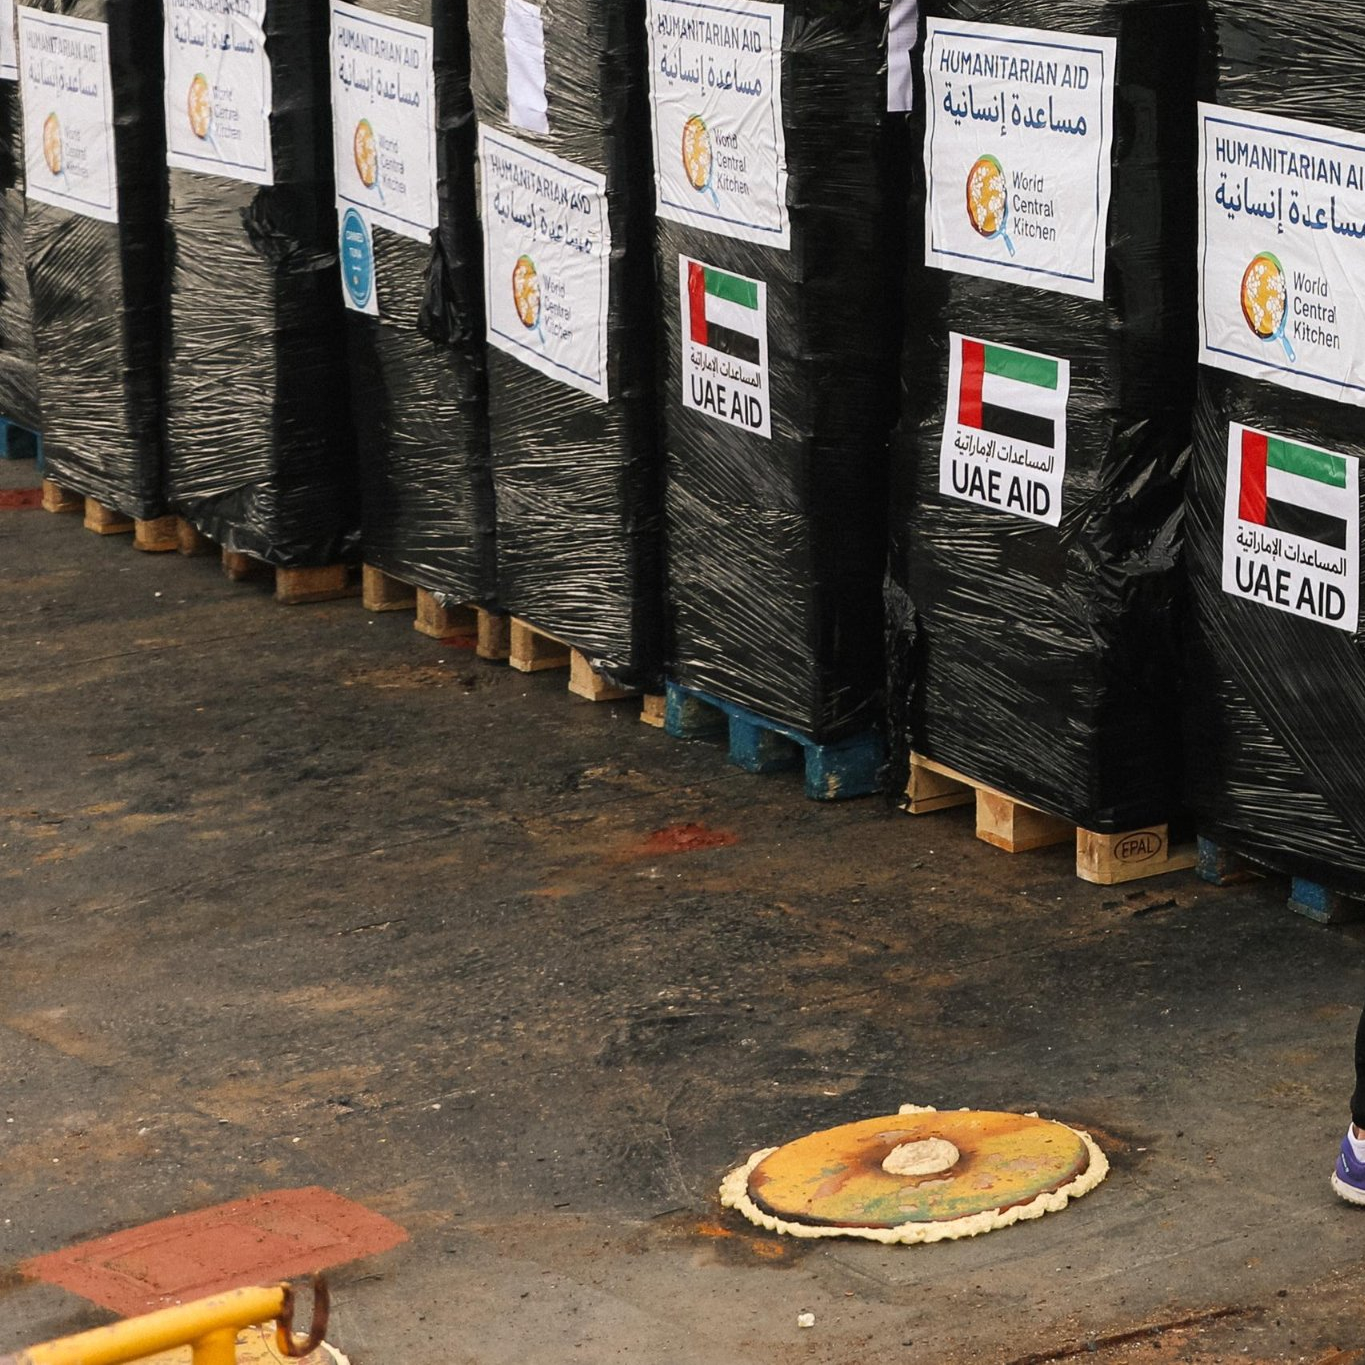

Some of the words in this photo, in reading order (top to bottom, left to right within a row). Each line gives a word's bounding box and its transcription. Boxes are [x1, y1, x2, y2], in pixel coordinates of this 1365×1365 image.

[337, 25, 401, 63] HUMANITARIAN
[402, 45, 420, 70] AID
[658, 13, 740, 50] HUMANITARIAN
[741, 28, 762, 54] AID
[660, 44, 707, 97] إنسانية
[707, 56, 762, 97] مساعدة
[939, 48, 1058, 86] HUMANITARIAN
[1060, 63, 1089, 90] AID
[942, 82, 1007, 137] إنسانية
[1011, 93, 1087, 137] مساعدة
[713, 128, 738, 149] World
[716, 150, 747, 174] Central
[1215, 137, 1342, 186] HUMANITARIAN
[490, 154, 568, 207] HUMANITARIAN
[571, 191, 591, 215] AID
[716, 174, 750, 196] Kitchen
[1012, 171, 1044, 194] World
[1012, 194, 1054, 218] Central
[1215, 172, 1284, 234] إنسانية
[540, 207, 593, 254] مساعدة
[1013, 218, 1056, 242] Kitchen
[543, 273, 566, 294] World
[1293, 271, 1328, 297] World
[544, 294, 571, 320] Central
[1293, 296, 1336, 324] Central
[545, 315, 573, 345] Kitchen
[1293, 321, 1340, 350] Kitchen
[690, 346, 719, 378] الإماراتية
[691, 373, 727, 417] UAE
[730, 390, 763, 428] AID
[954, 430, 996, 463] الإماراتية
[997, 445, 1054, 474] المساعدات
[952, 459, 1002, 505] UAE
[1006, 475, 1050, 516] AID
[1236, 526, 1282, 562] الإماراتية
[1284, 544, 1347, 577] المساعدات
[1235, 555, 1291, 607] UAE
[1295, 576, 1346, 621] AID
[1122, 836, 1154, 859] EPAL
